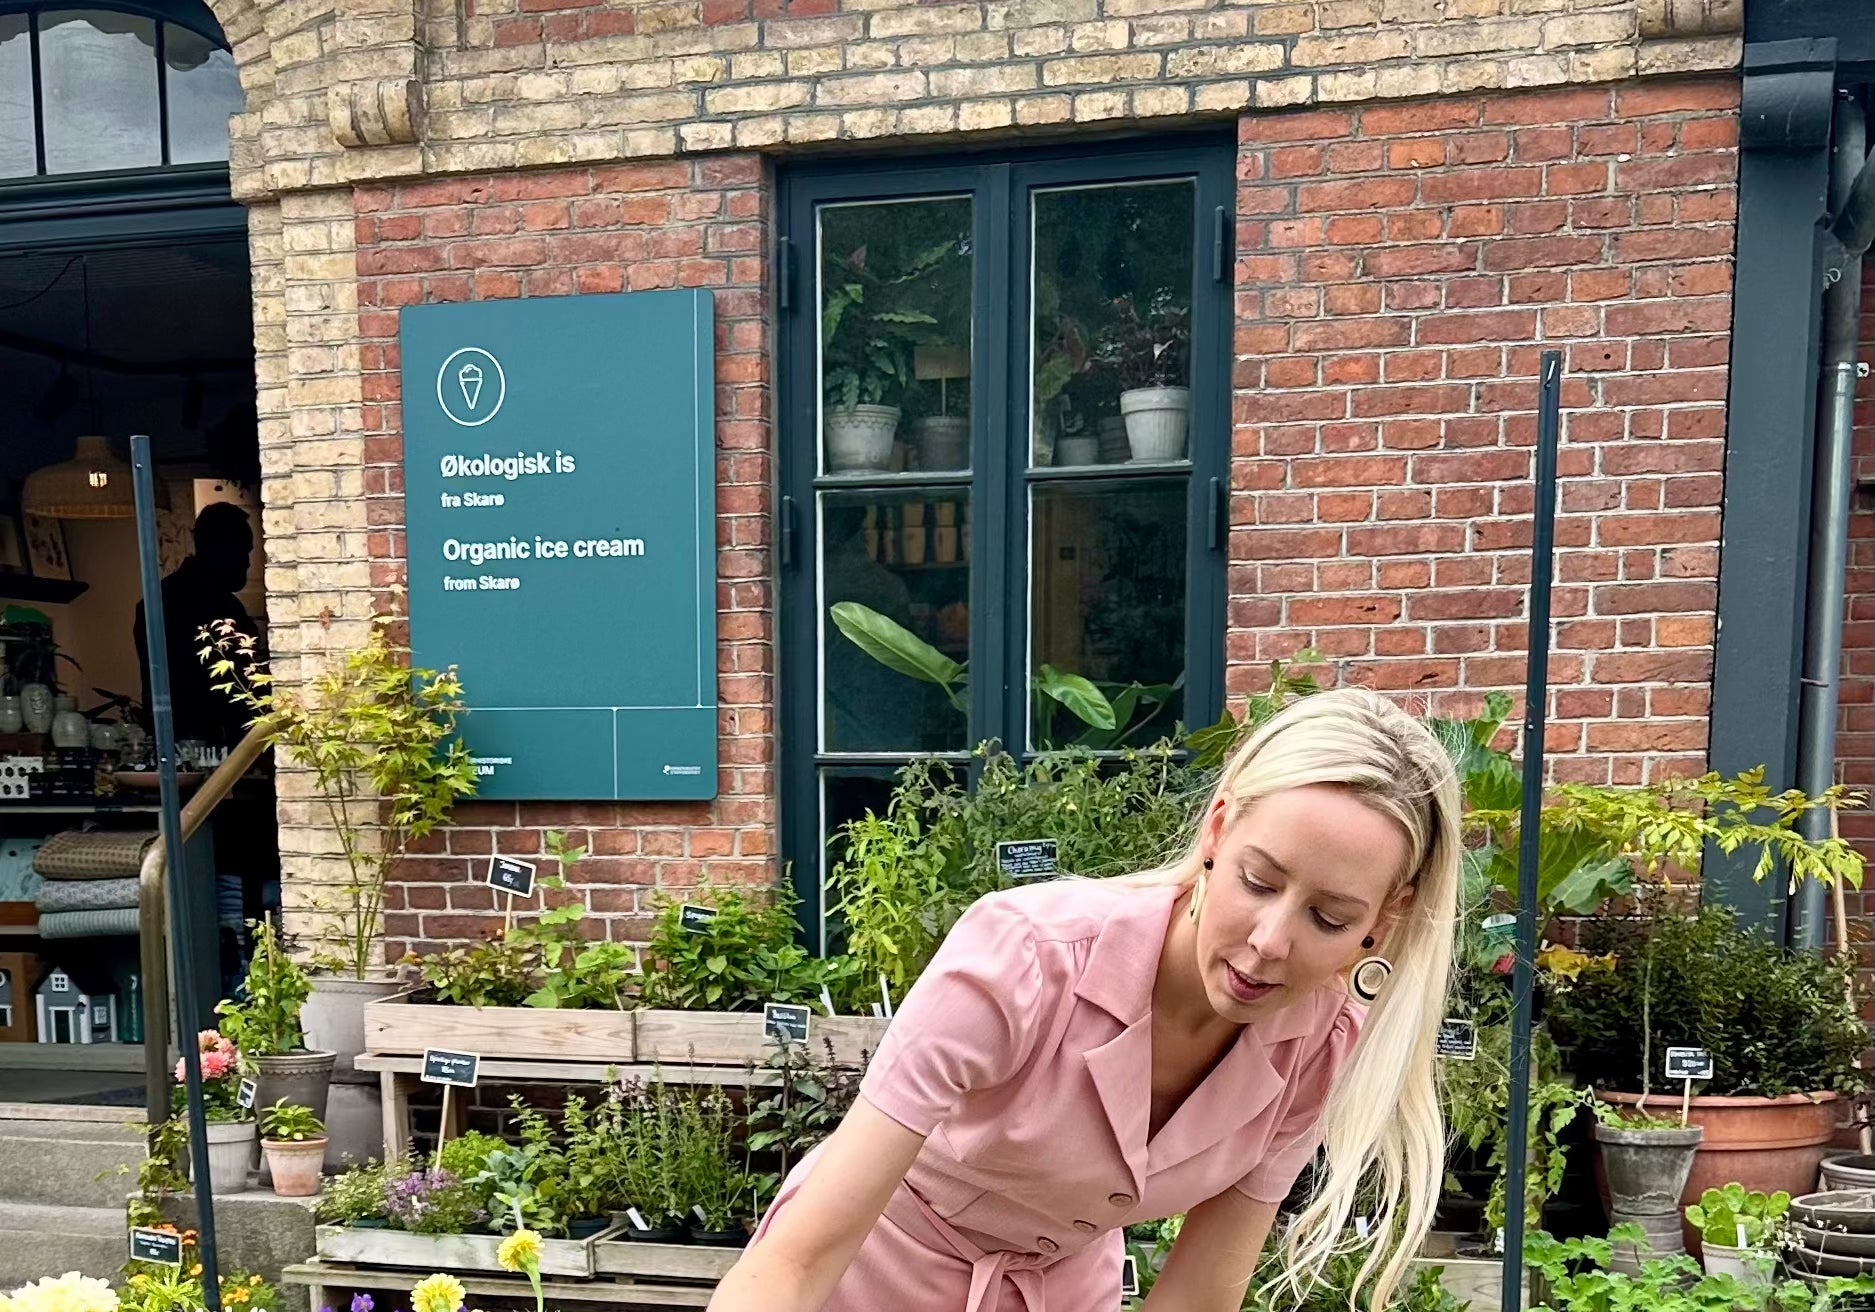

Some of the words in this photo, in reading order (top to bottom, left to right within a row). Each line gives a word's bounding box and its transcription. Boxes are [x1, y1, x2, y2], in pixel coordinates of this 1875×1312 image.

[440, 451, 551, 481] Økologisk
[555, 449, 576, 473] is
[441, 492, 461, 508] fra
[443, 536, 531, 566] Organic
[535, 535, 569, 558] ice
[573, 538, 645, 558] cream
[444, 576, 477, 591] from
